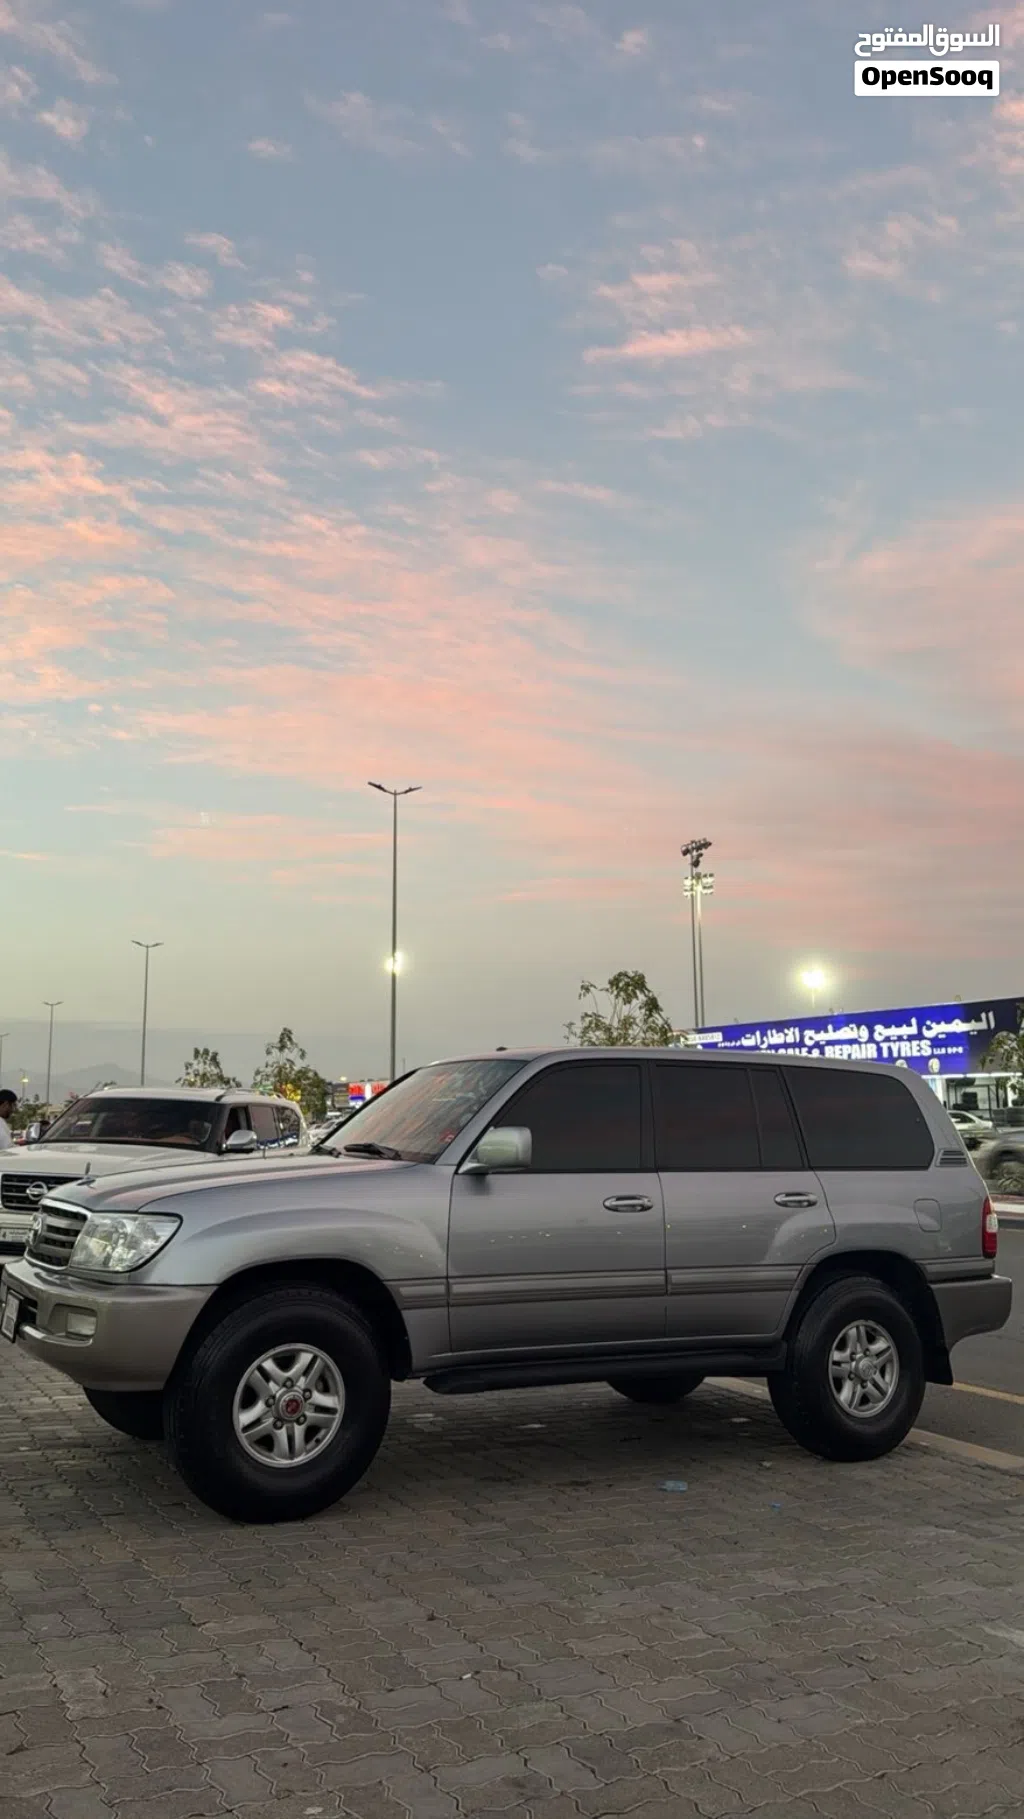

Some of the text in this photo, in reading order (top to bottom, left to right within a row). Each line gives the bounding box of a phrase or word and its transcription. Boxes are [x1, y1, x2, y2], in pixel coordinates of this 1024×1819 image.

[803, 1022, 870, 1047] وتصليح
[873, 1016, 919, 1041] لبيع
[922, 1011, 996, 1039] اليمين
[824, 1043, 878, 1060] REPAIR
[880, 1039, 932, 1058] TYRES
